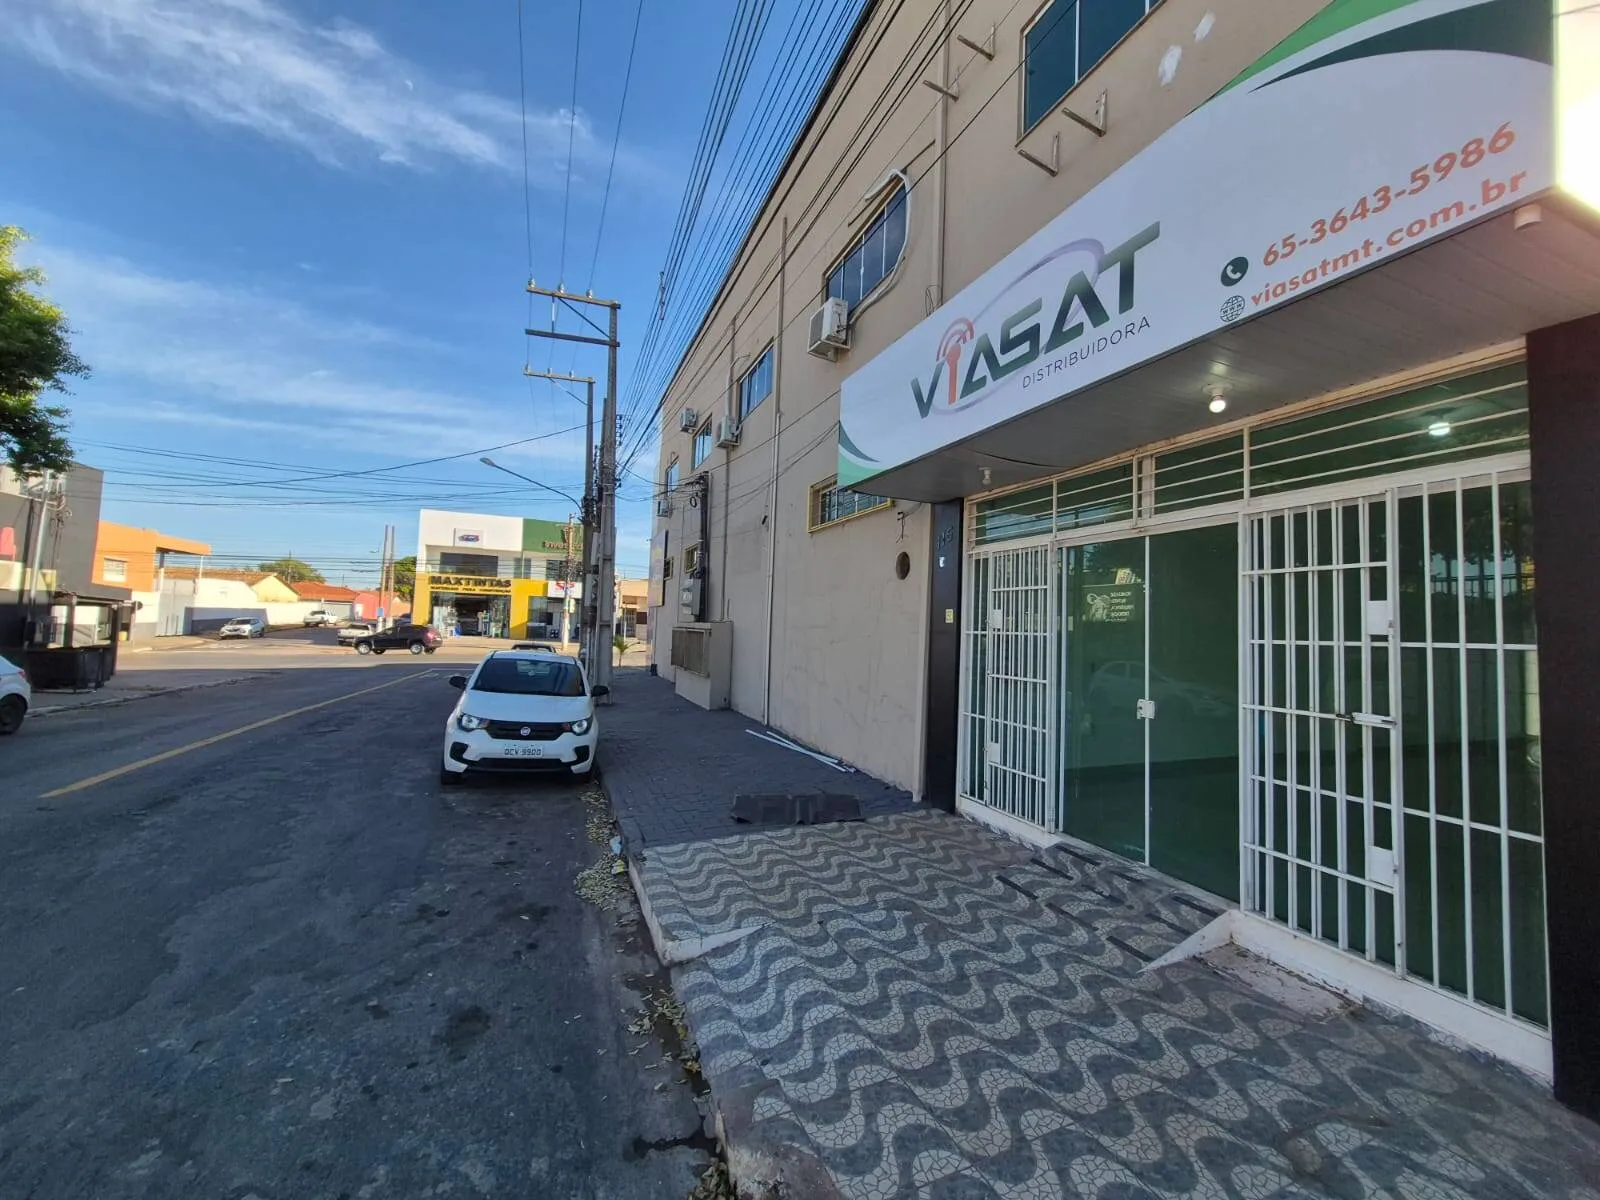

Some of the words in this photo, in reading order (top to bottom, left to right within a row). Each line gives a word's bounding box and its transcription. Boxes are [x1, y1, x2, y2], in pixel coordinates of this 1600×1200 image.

[1250, 171, 1527, 306] viasatmt.com.br
[1263, 121, 1516, 267] 65-3643-5986
[910, 220, 1161, 419] VIASAT
[1022, 315, 1151, 389] DISTRIBUIDORA
[430, 575, 512, 588] MAXTINTAS
